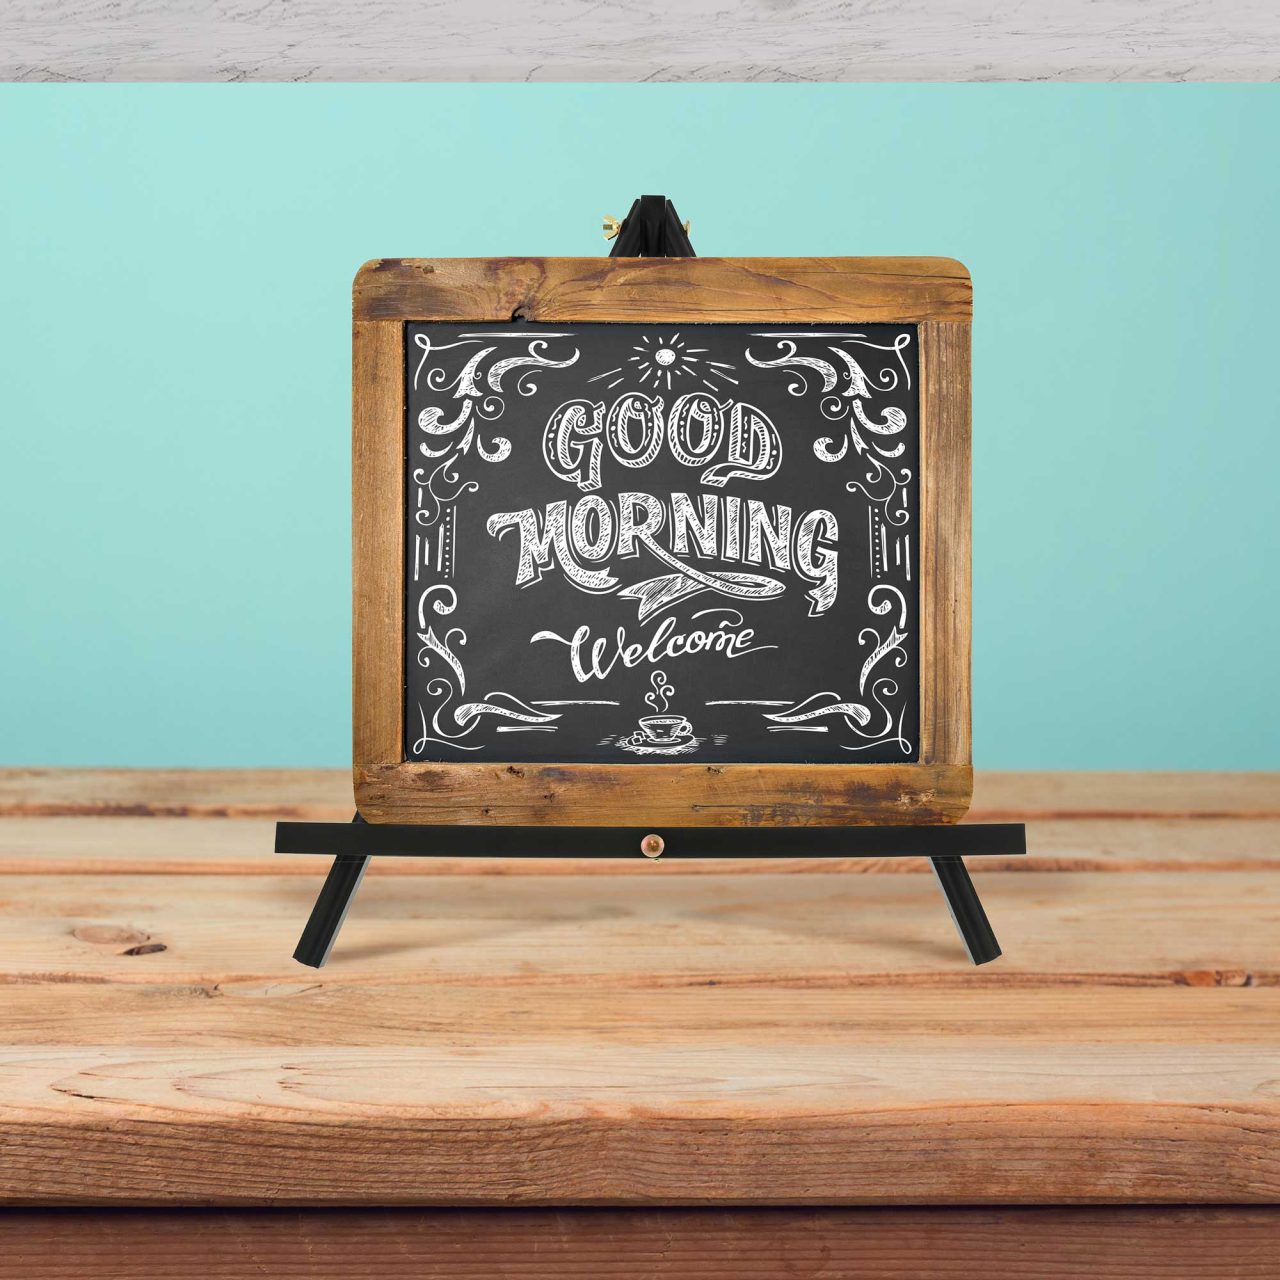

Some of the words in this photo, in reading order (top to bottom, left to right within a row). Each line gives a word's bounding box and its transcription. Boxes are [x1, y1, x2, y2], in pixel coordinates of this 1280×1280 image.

[543, 391, 783, 491] GOOD
[487, 493, 839, 622] MORNING
[530, 609, 779, 682] Welcome
